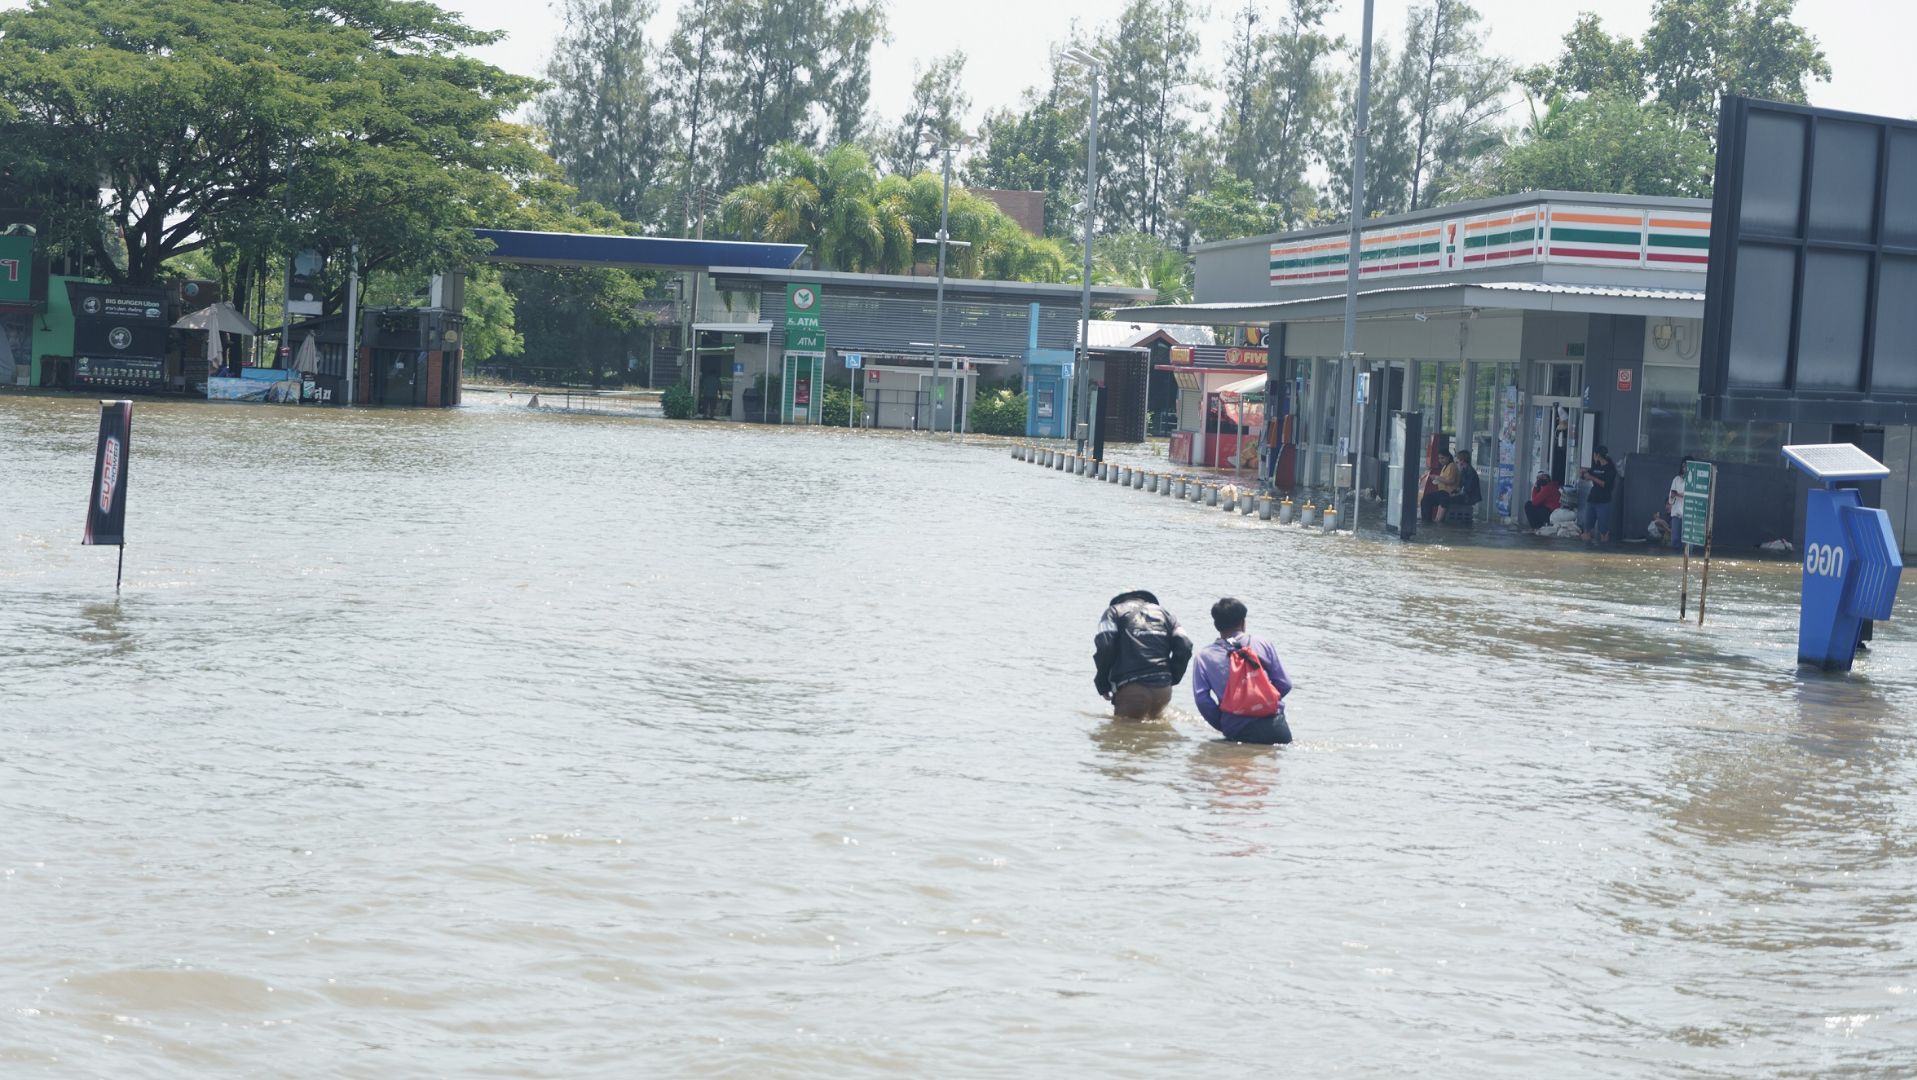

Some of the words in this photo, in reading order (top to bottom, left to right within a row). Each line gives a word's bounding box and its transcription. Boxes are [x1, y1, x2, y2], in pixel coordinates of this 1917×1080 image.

[797, 317, 818, 327] ATM
[797, 337, 817, 347] ATM
[1243, 351, 1268, 364] FIVE
[101, 440, 115, 511] SUPER
[1806, 542, 1844, 578] ออก
